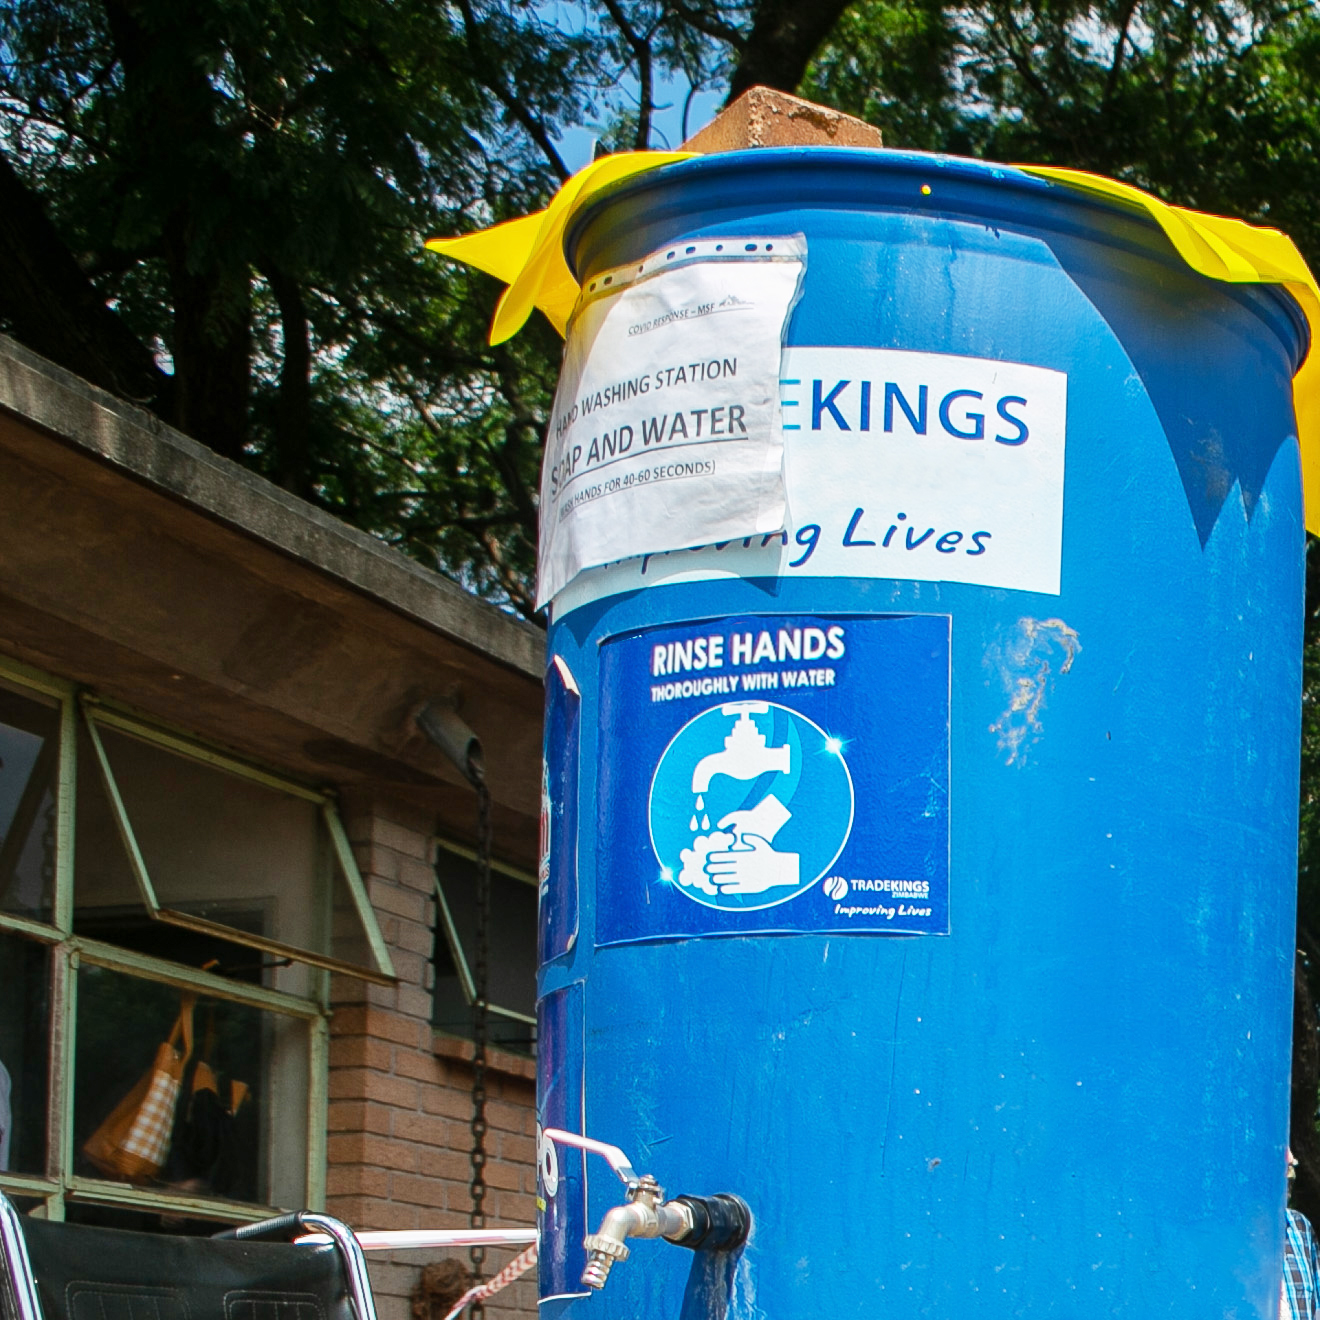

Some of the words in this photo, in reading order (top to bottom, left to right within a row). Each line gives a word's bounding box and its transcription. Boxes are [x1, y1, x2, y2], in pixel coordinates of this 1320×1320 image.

[628, 321, 652, 335] COVID
[652, 308, 689, 328] RESPONSE
[698, 303, 715, 315] MSF
[581, 375, 650, 417] WASHING
[655, 357, 738, 389] STATION
[586, 425, 634, 466] AND
[642, 404, 748, 446] WATER
[574, 484, 602, 505] HANDS
[604, 476, 621, 495] FOR
[623, 469, 651, 485] 40-60
[653, 459, 716, 479] SECONDS)
[842, 507, 992, 555] Lives
[653, 635, 724, 677] RINSE
[732, 626, 846, 666] HANDS
[651, 676, 739, 702] THOROUGHLY
[742, 672, 778, 691] WITH
[781, 668, 836, 687] WATER
[850, 879, 930, 893] TRADEKINGS
[891, 892, 929, 900] ZIMBABWE
[834, 903, 896, 920] Improving
[897, 904, 932, 917] Lives
